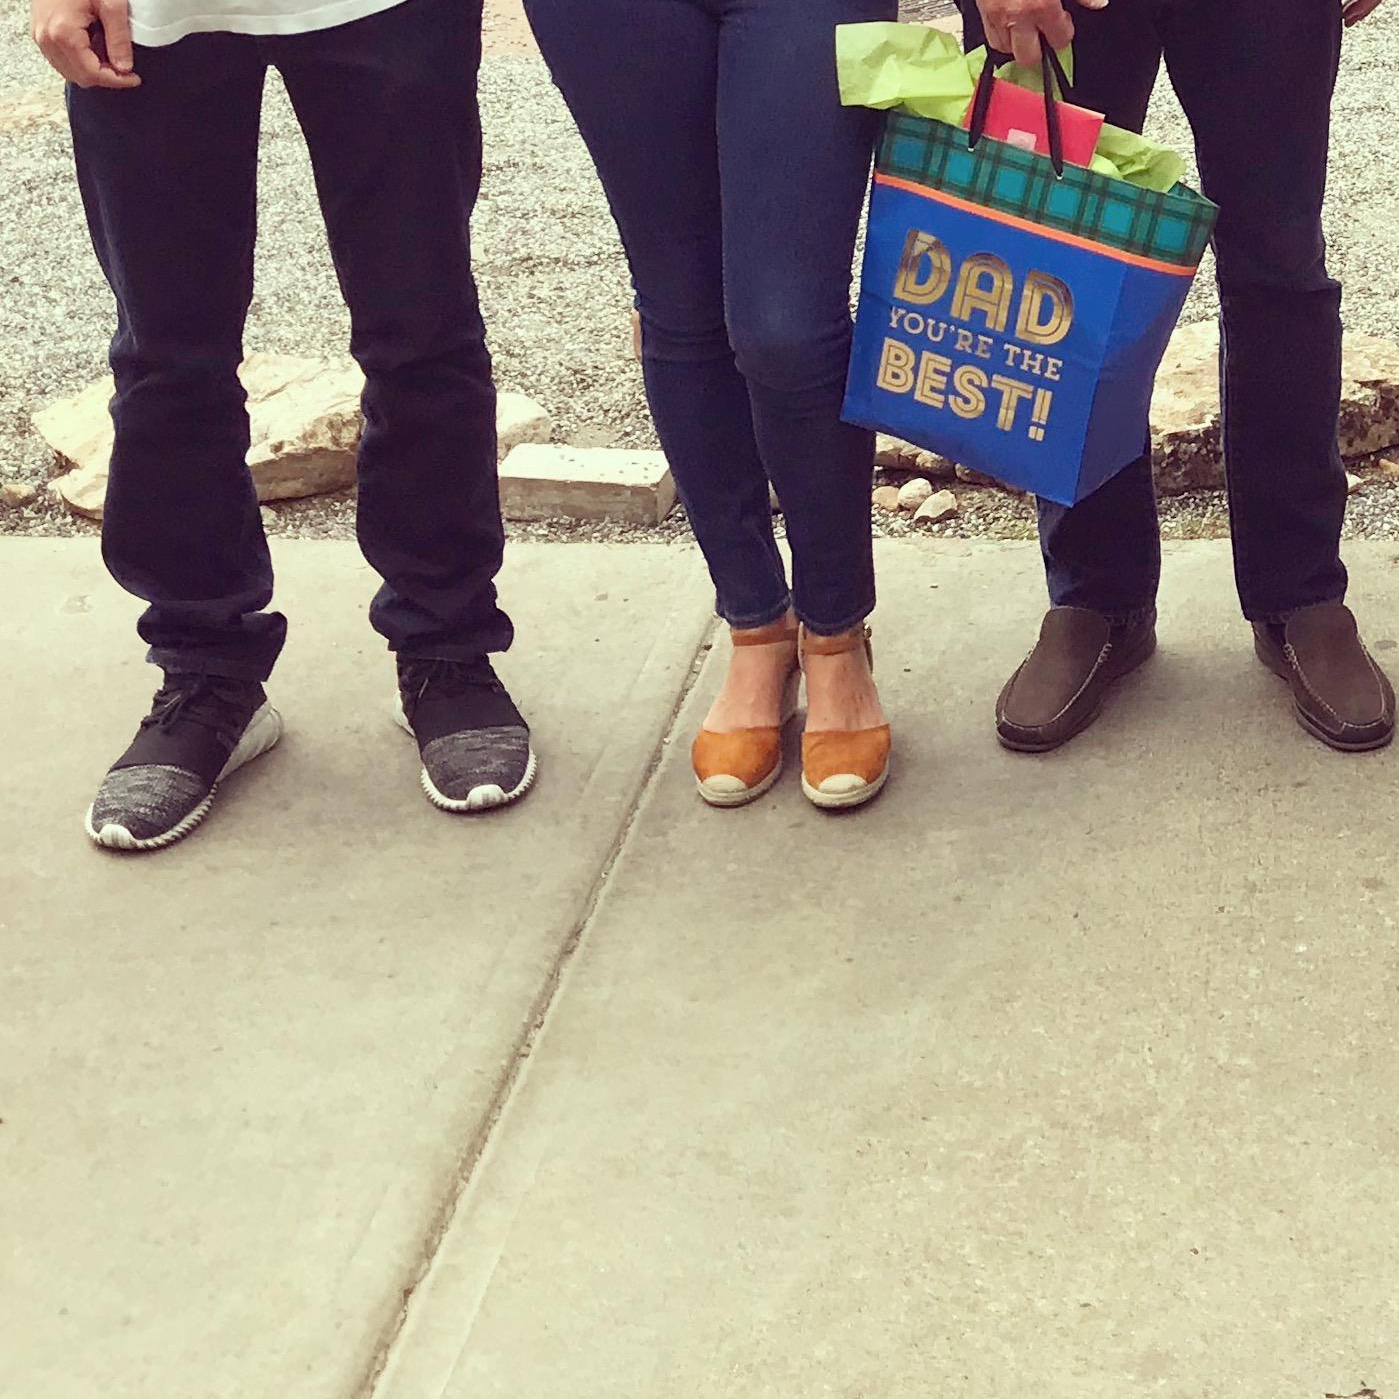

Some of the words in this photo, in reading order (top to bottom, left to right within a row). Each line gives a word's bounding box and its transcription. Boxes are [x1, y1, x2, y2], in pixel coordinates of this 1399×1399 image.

[893, 227, 1074, 346] DAD
[875, 336, 1053, 442] BEST!
[888, 305, 993, 360] YOU'RE
[1003, 342, 1063, 381] THE
